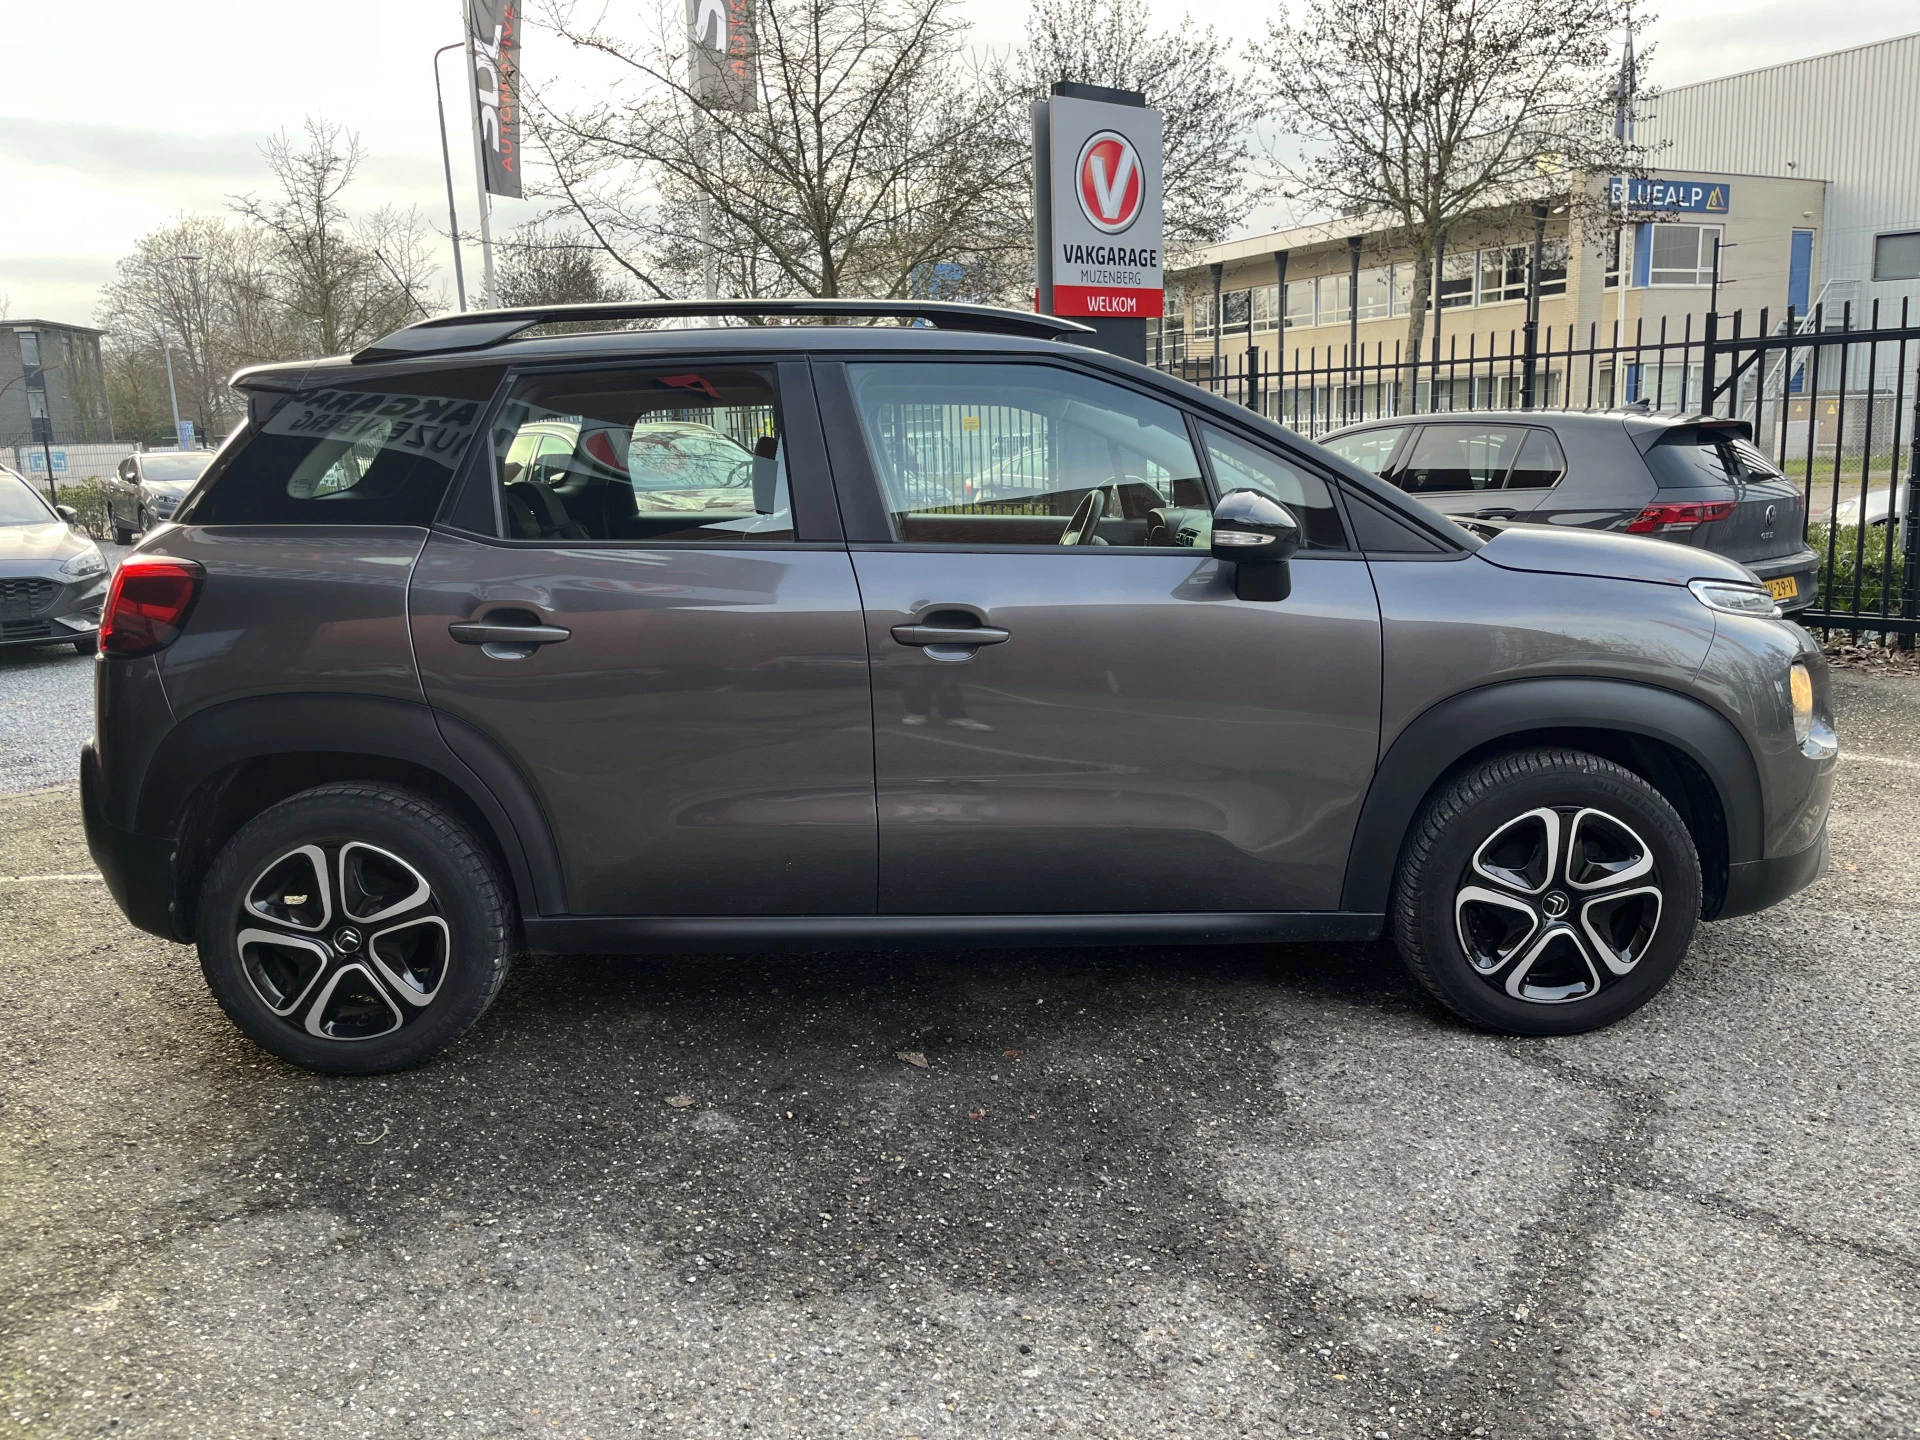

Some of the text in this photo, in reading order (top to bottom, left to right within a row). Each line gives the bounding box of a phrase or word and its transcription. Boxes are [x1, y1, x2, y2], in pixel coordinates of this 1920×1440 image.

[500, 4, 515, 173] AUTOMOTIVE
[1611, 183, 1703, 206] BLUEALP
[1063, 244, 1157, 268] VAKGARAGE
[1080, 269, 1142, 286] MUZENBERG
[1086, 295, 1137, 313] WELKOM
